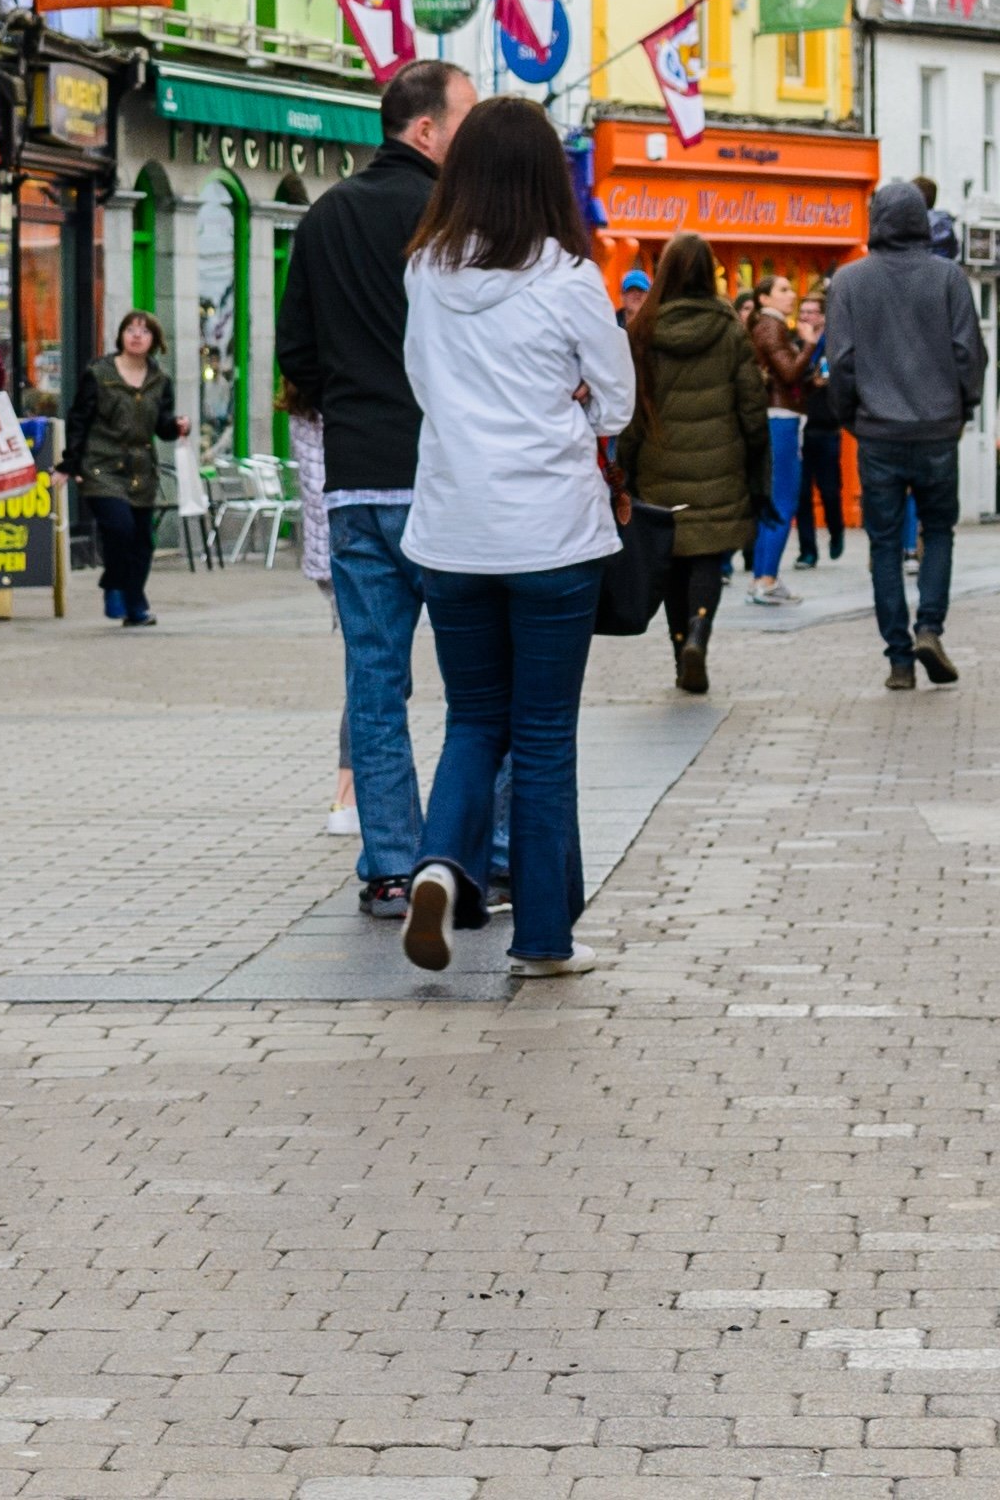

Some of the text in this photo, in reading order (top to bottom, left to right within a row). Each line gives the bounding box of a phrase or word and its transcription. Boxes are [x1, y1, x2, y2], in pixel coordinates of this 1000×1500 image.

[608, 184, 853, 231] Galway Woollen Market
